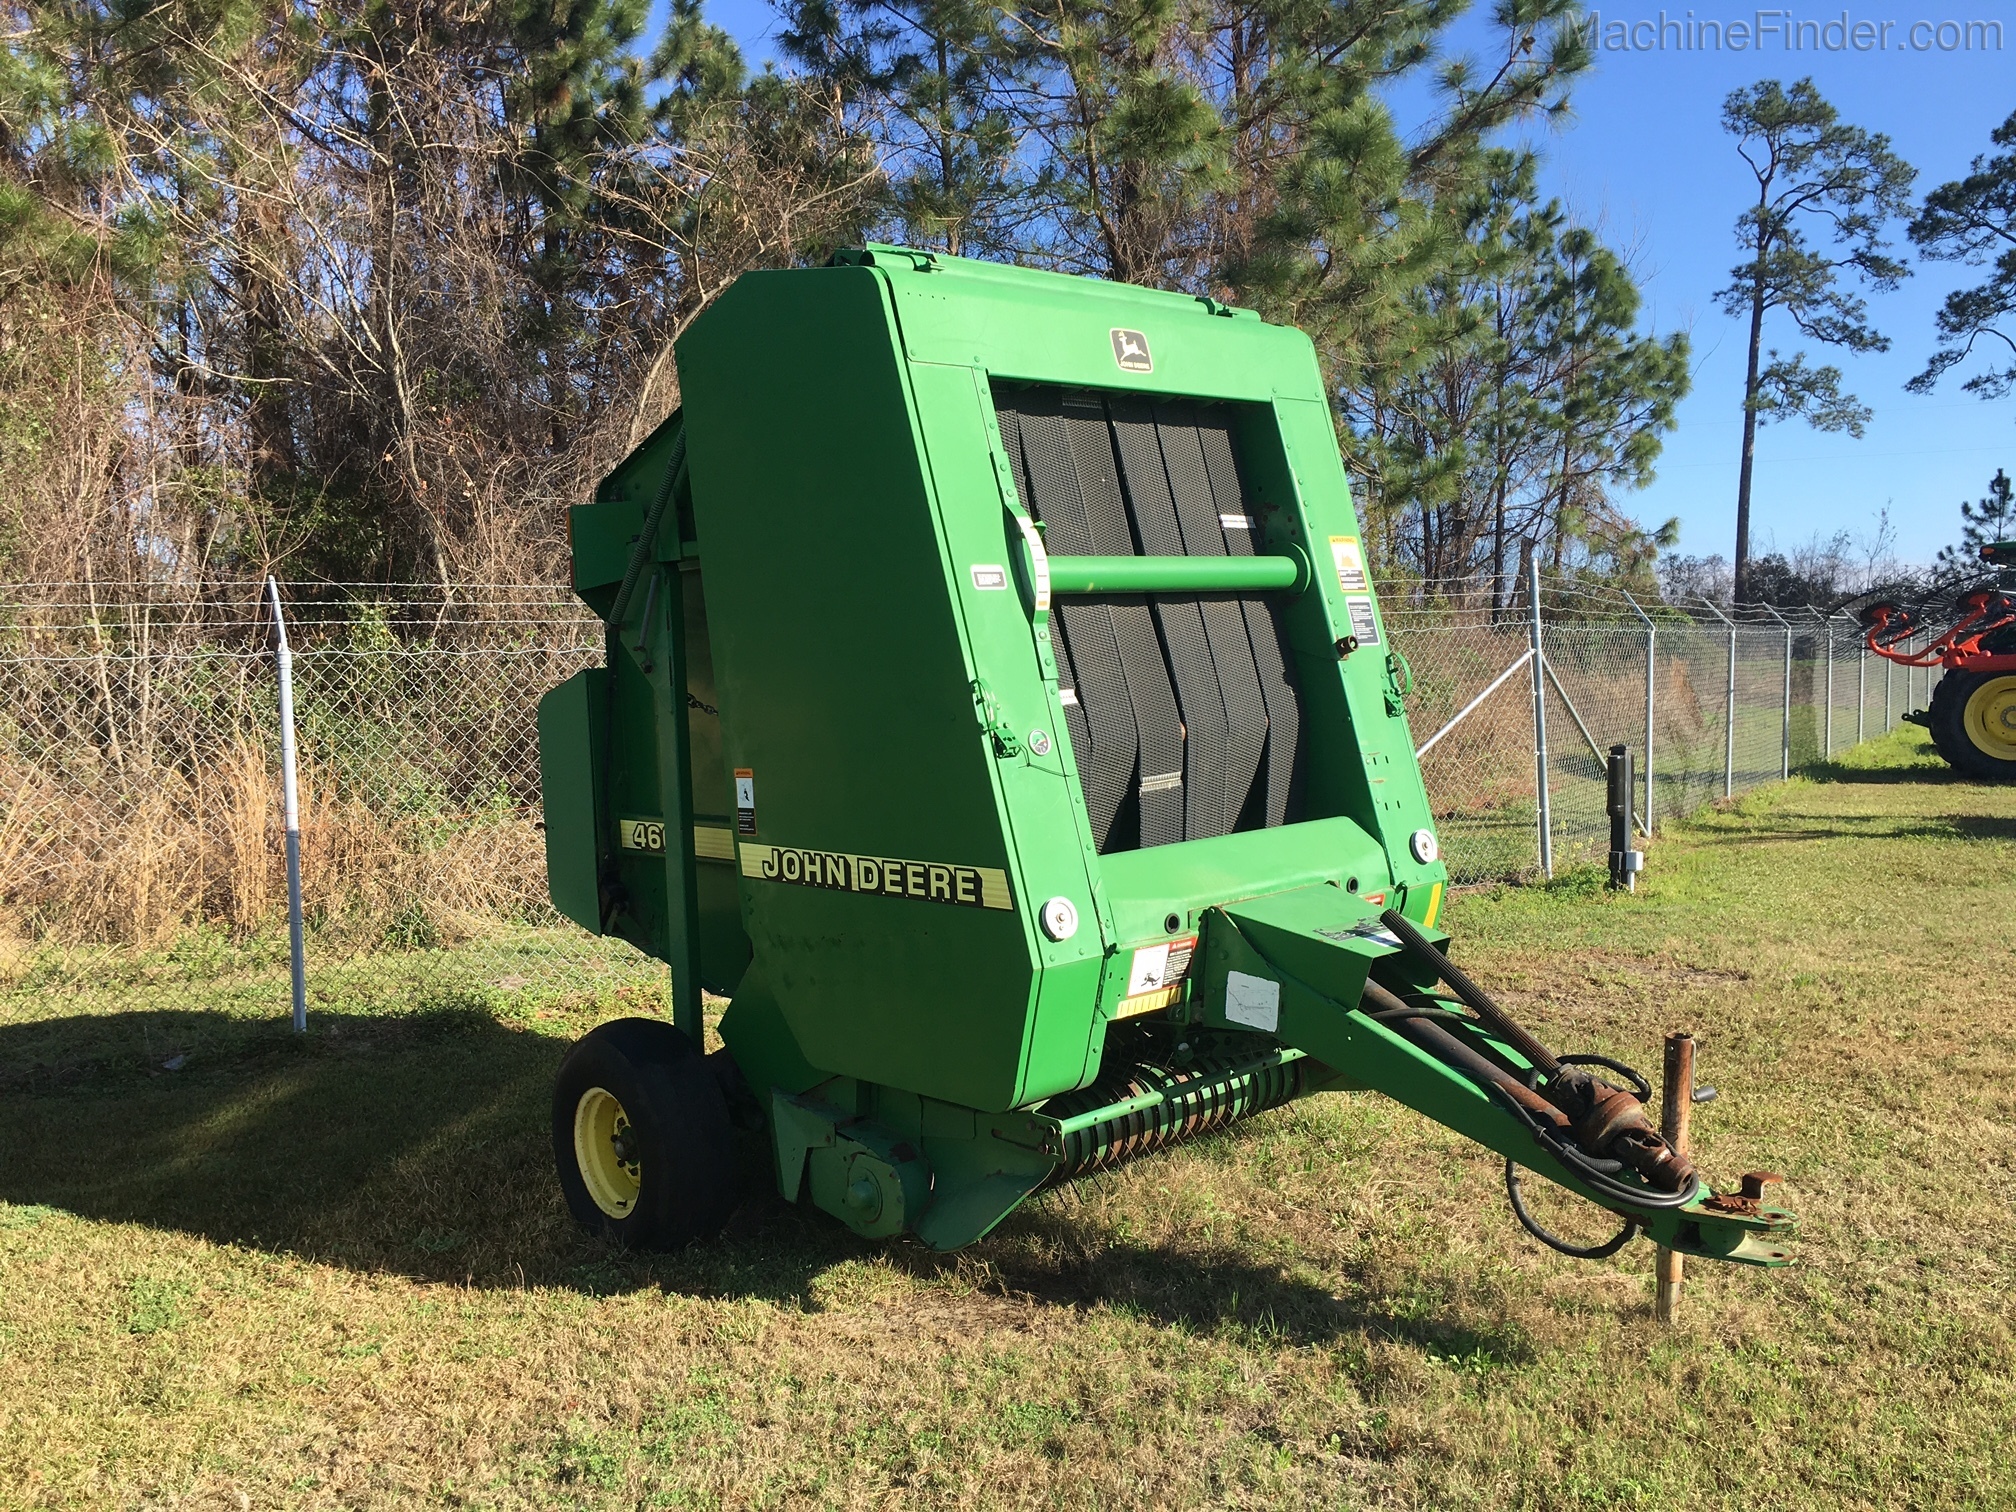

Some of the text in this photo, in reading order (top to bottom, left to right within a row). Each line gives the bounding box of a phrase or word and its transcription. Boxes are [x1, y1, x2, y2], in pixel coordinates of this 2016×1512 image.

[633, 823, 666, 850] 46
[762, 848, 979, 904] JOHN DEERE
